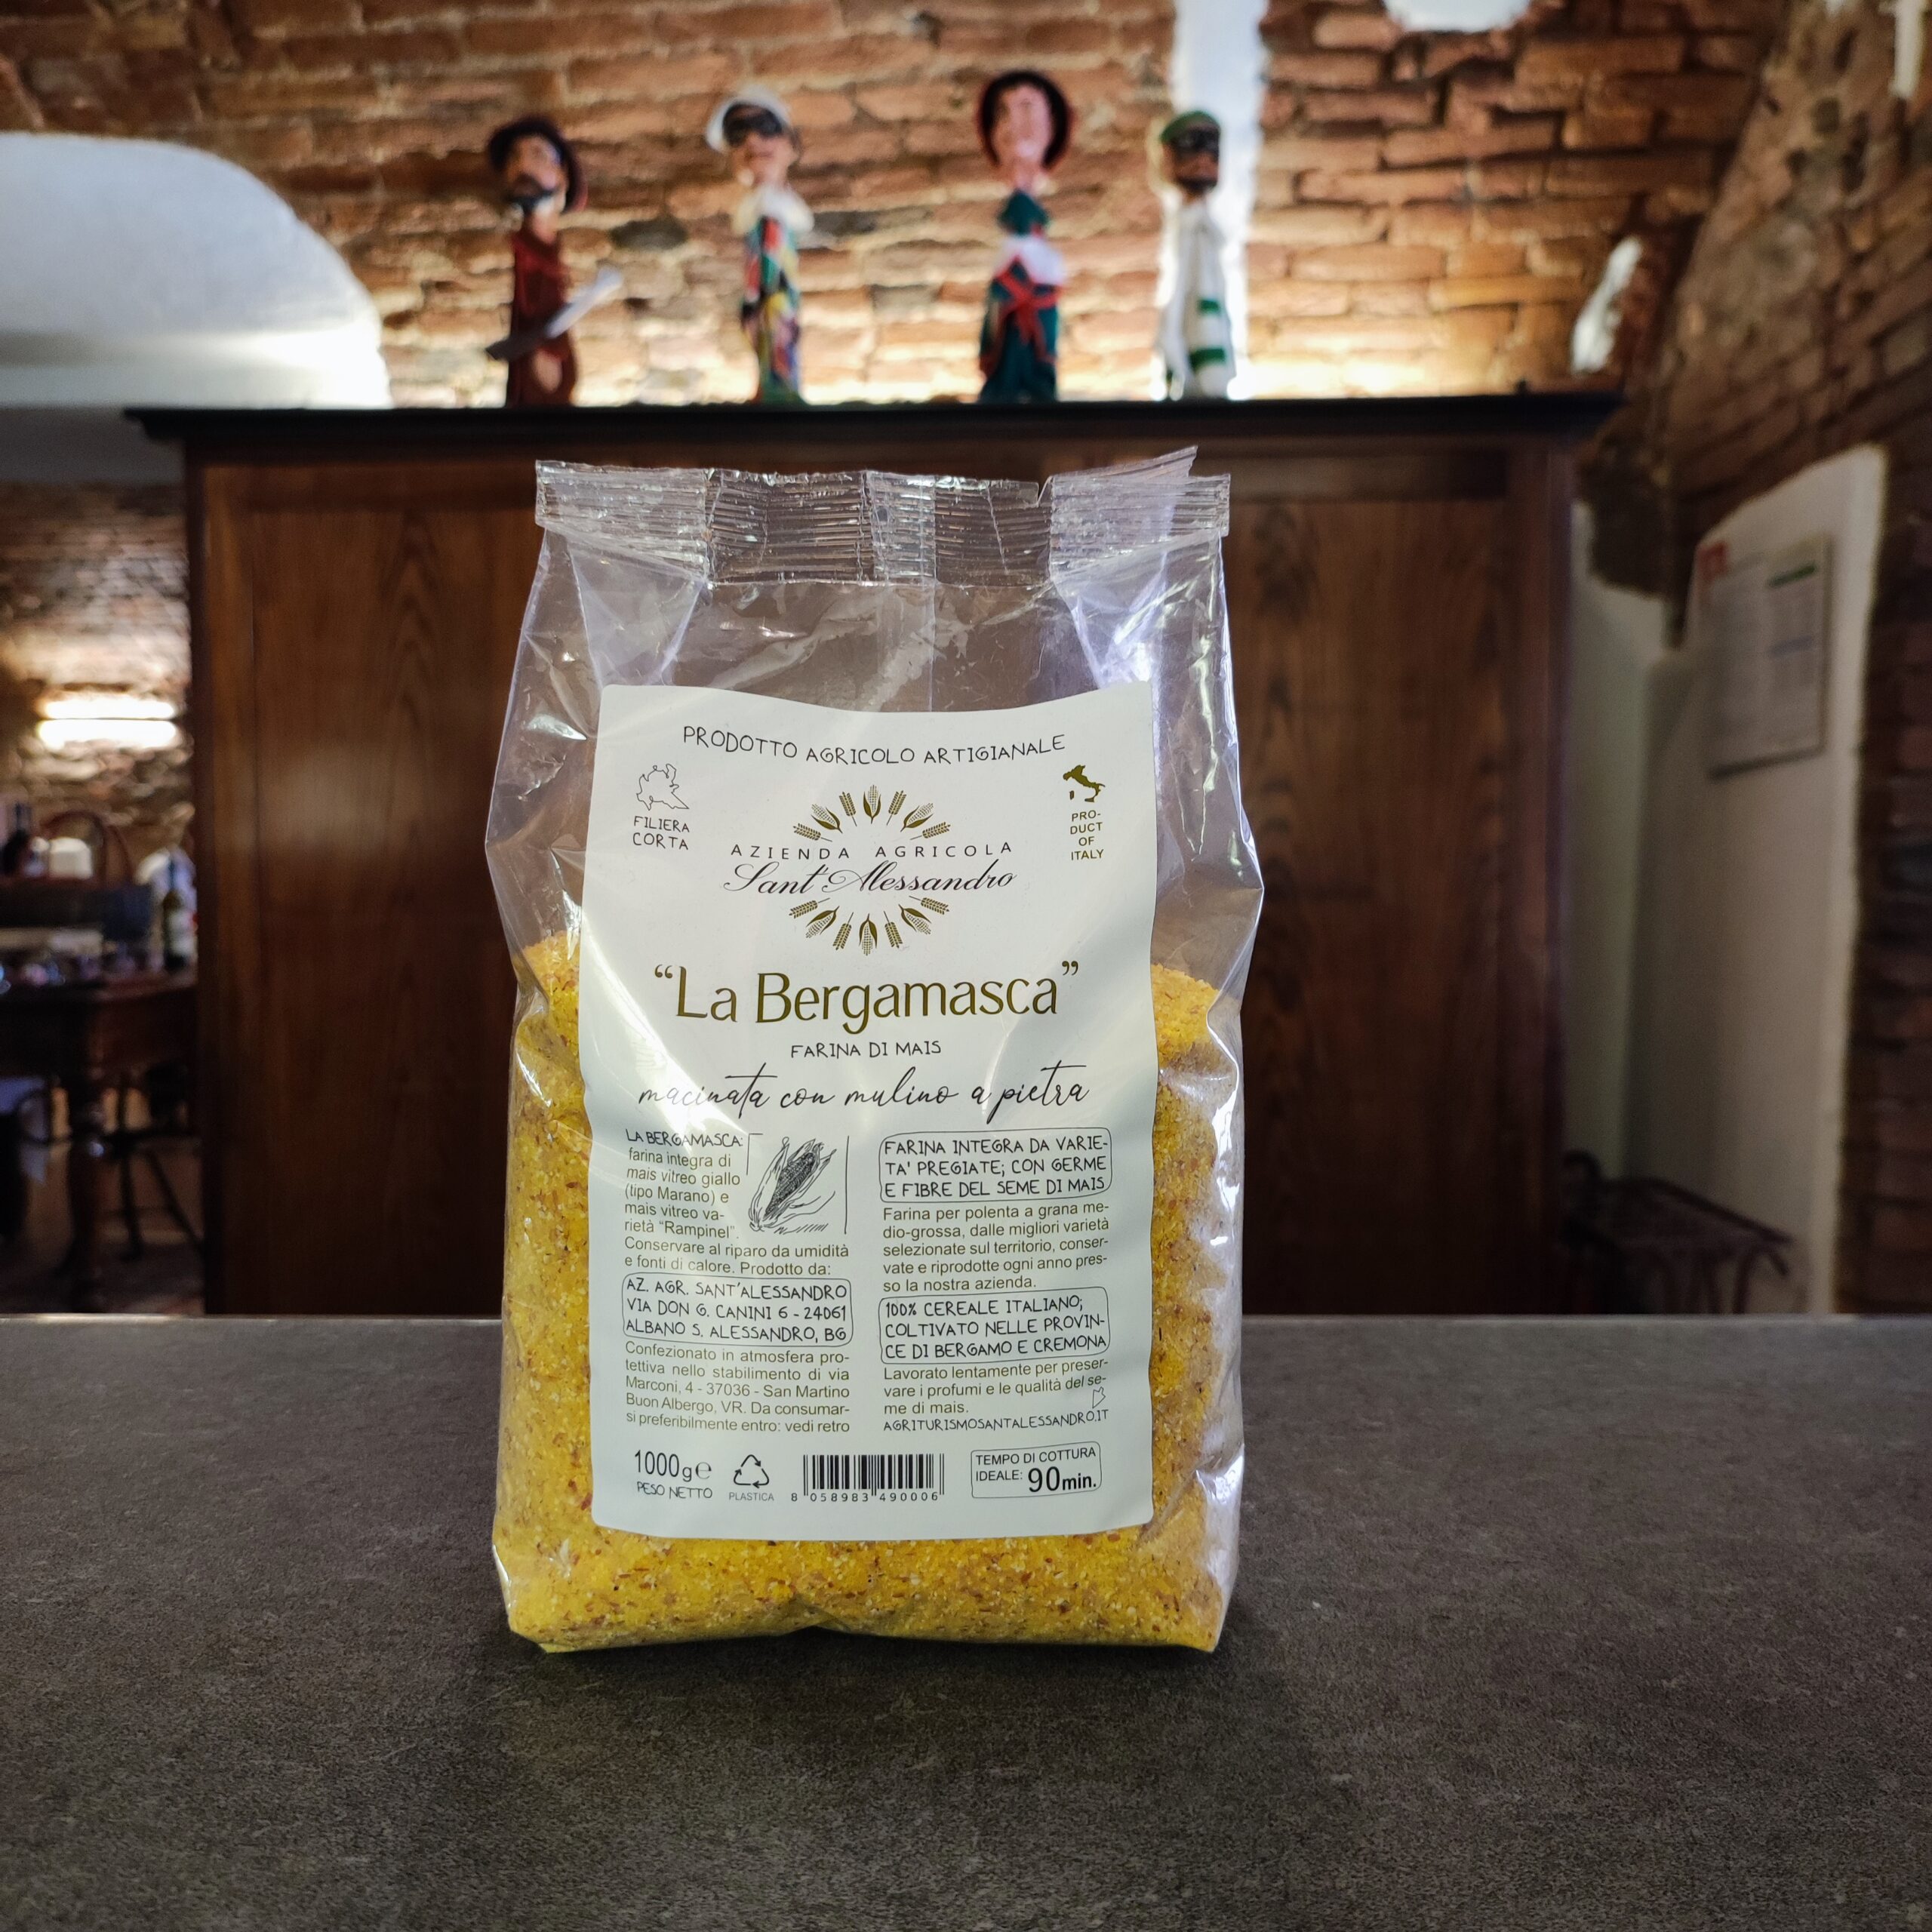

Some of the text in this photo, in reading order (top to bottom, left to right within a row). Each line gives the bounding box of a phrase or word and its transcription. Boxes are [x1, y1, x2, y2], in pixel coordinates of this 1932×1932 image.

[684, 726, 1065, 765] PRODOTTO AGRICOLO ARTIGIANALE
[634, 816, 690, 832] FILIERA
[1072, 810, 1101, 822] PRO-
[1070, 822, 1103, 835] DUCT
[633, 832, 688, 851] CORTA
[731, 841, 1011, 860] AZIENDA AGRICOLA
[1078, 836, 1094, 846] OF
[1072, 849, 1104, 860] ITALY
[791, 1041, 941, 1059] FARINA DI MAIS
[638, 1060, 1090, 1124] macinata con mulino a pietra
[626, 1128, 743, 1147] LA BERGAMASCA:
[884, 1135, 1108, 1156] FARINA INTEGRA DA VARIE-
[629, 1147, 731, 1171] farina integra di
[885, 1155, 1106, 1177] TA' PREGIATE; CON GERME
[627, 1168, 740, 1188] mais vitreo giallo
[885, 1177, 1104, 1198] E FIBRE DEL SEME DI MAIS
[626, 1183, 715, 1207] (tipo Marano)
[625, 1202, 724, 1220] mais vitreo va-
[884, 1203, 1109, 1223] Farina per polenta grana me-
[625, 1220, 654, 1232] rietà
[883, 1217, 1109, 1241] dio-grossa, dalle migliori varietà
[625, 1236, 848, 1260] Conservare al riparo da umidità
[883, 1238, 1108, 1257] selezionate sul territorio, conser-
[637, 1254, 830, 1275] fonti calore. Prodotto da:
[883, 1255, 1107, 1276] vate riprodotte ogni anno pres-
[627, 1277, 847, 1302] AZ. AGR. SANT'ALESSANDRO
[924, 1275, 1036, 1291] nostra azienda.
[627, 1297, 845, 1321] VIA DON G. CANINI 6 24061
[886, 1295, 1082, 1318] 100% CEREALE ITALIANO;
[626, 1318, 846, 1343] ALBANO S. ALESSANDRO, BG
[885, 1313, 1105, 1338] COLTIVATO NELLE PROVIN-
[626, 1341, 849, 1366] Confezionato in atmosfera pro-
[885, 1334, 1106, 1359] CE DI BERGAMO E CREMONA
[626, 1358, 849, 1380] tettiva nello stabilimento di via
[884, 1359, 1108, 1380] Lavorato lentamente per preser-
[626, 1375, 850, 1398] Marconi, 4 37036 San Martino
[884, 1375, 1084, 1399] vare profumi le qualità del
[626, 1392, 850, 1415] Buon Albergo, VR. Da consumar-
[912, 1401, 968, 1414] di mais.
[639, 1414, 850, 1432] preferibilmente entro: vedi retro
[884, 1409, 1109, 1432] AGRITURISMOSANTALESSANDRO.IT
[976, 1447, 1096, 1466] TEMPO DI COTTURA
[976, 1469, 1023, 1481] IDEALE:
[637, 1481, 712, 1499] PESO NETTO
[729, 1492, 774, 1501] PLASTICA
